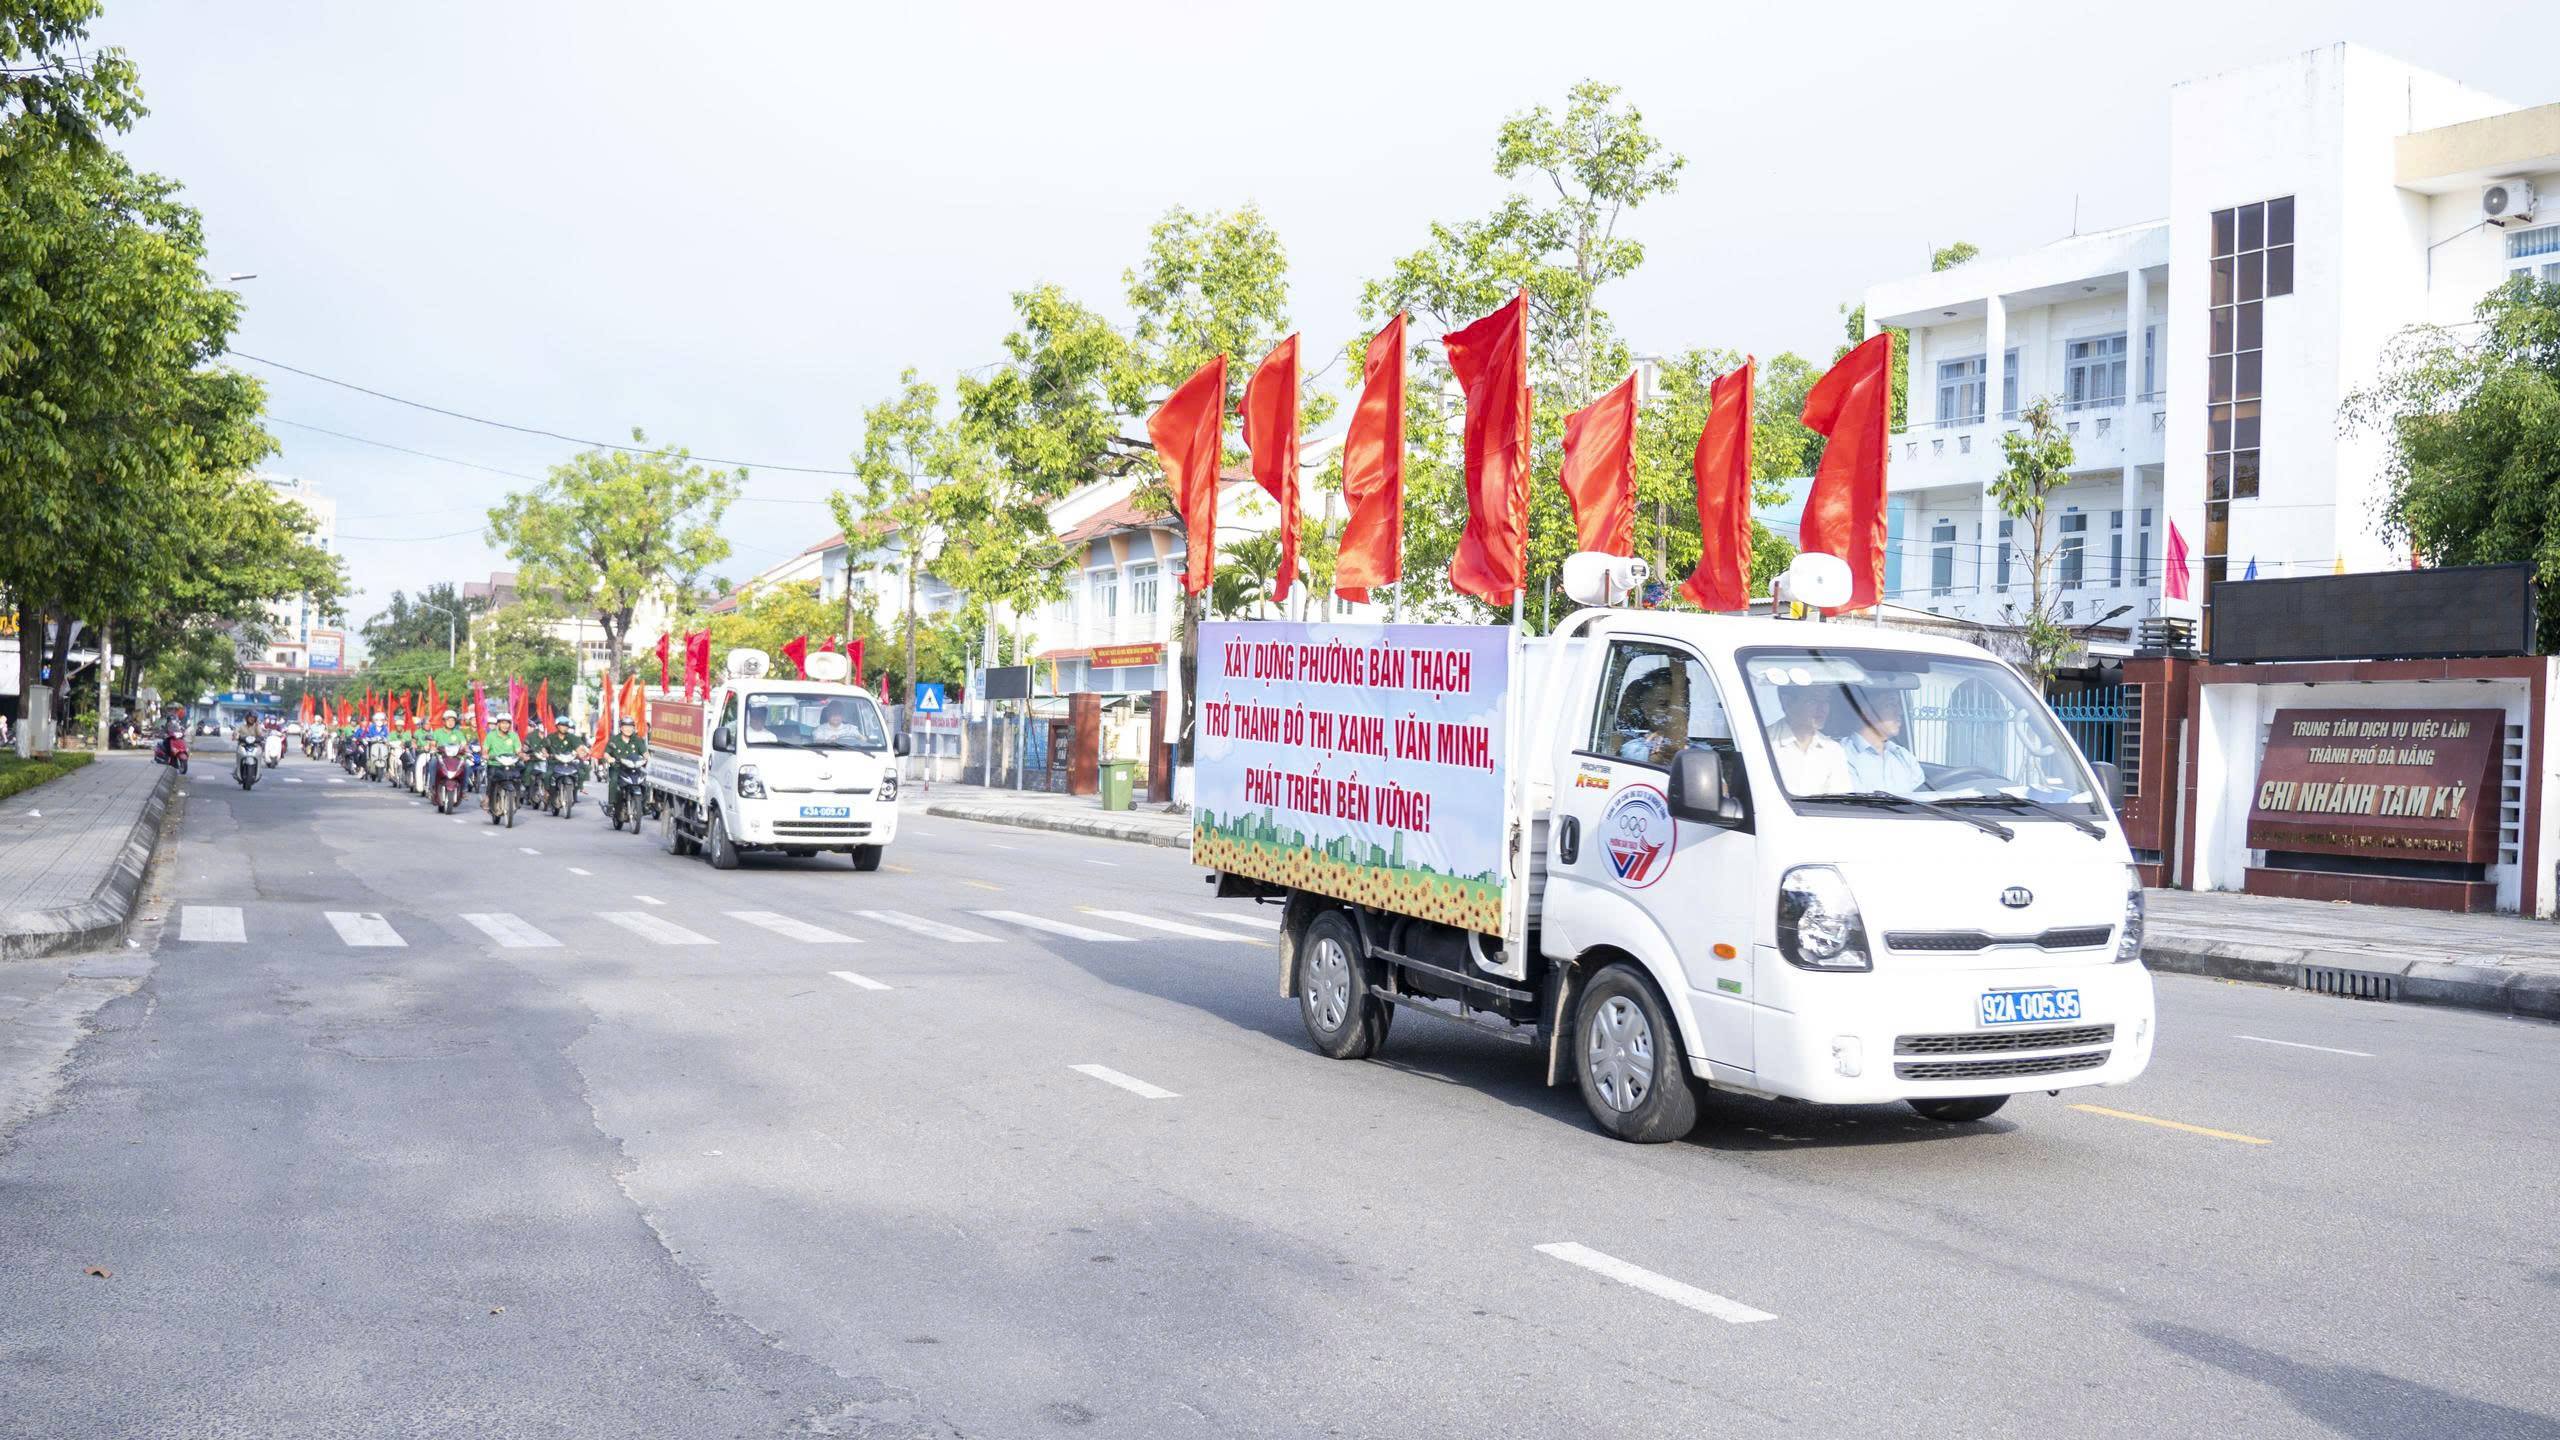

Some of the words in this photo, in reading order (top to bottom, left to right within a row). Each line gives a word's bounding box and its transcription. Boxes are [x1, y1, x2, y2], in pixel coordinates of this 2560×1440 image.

[1224, 636, 1252, 677] XÂY
[1254, 642, 1294, 687] DỰNG
[1299, 637, 1363, 686] PHƯỜNG
[1369, 641, 1404, 689] BÀN
[1411, 650, 1471, 700] THẠCH
[1205, 692, 1231, 738] TRỞ
[1234, 698, 1279, 744] THÀNH
[1284, 702, 1304, 747] ĐÔ
[1309, 711, 1333, 758] THỊ
[1337, 714, 1389, 761] XANH,
[1395, 712, 1431, 762] VĂN
[1437, 723, 1494, 774] MINH,
[2292, 721, 2330, 737] TRUNG
[2332, 719, 2358, 737] TÂM
[2359, 722, 2388, 740] DỊCH
[2391, 722, 2409, 740] VỤ
[2411, 719, 2440, 741] VIỆC
[2441, 718, 2470, 738] LÀM
[2308, 745, 2350, 764] THÀNH
[2350, 744, 2378, 764] PHỐ
[2378, 745, 2396, 765] ĐÀ
[1245, 763, 1282, 806] PHÁT
[1286, 762, 1331, 816] TRIỂN
[1336, 771, 1369, 823] BỀN
[1375, 781, 1431, 833] VỮNG!
[2258, 781, 2296, 811] CHI
[2298, 777, 2374, 815] NHÁNH
[2380, 785, 2430, 817] TAM
[2430, 780, 2467, 818] KỲ
[2003, 889, 2031, 905] KIA
[1983, 991, 2079, 1021] 92A-005.95
